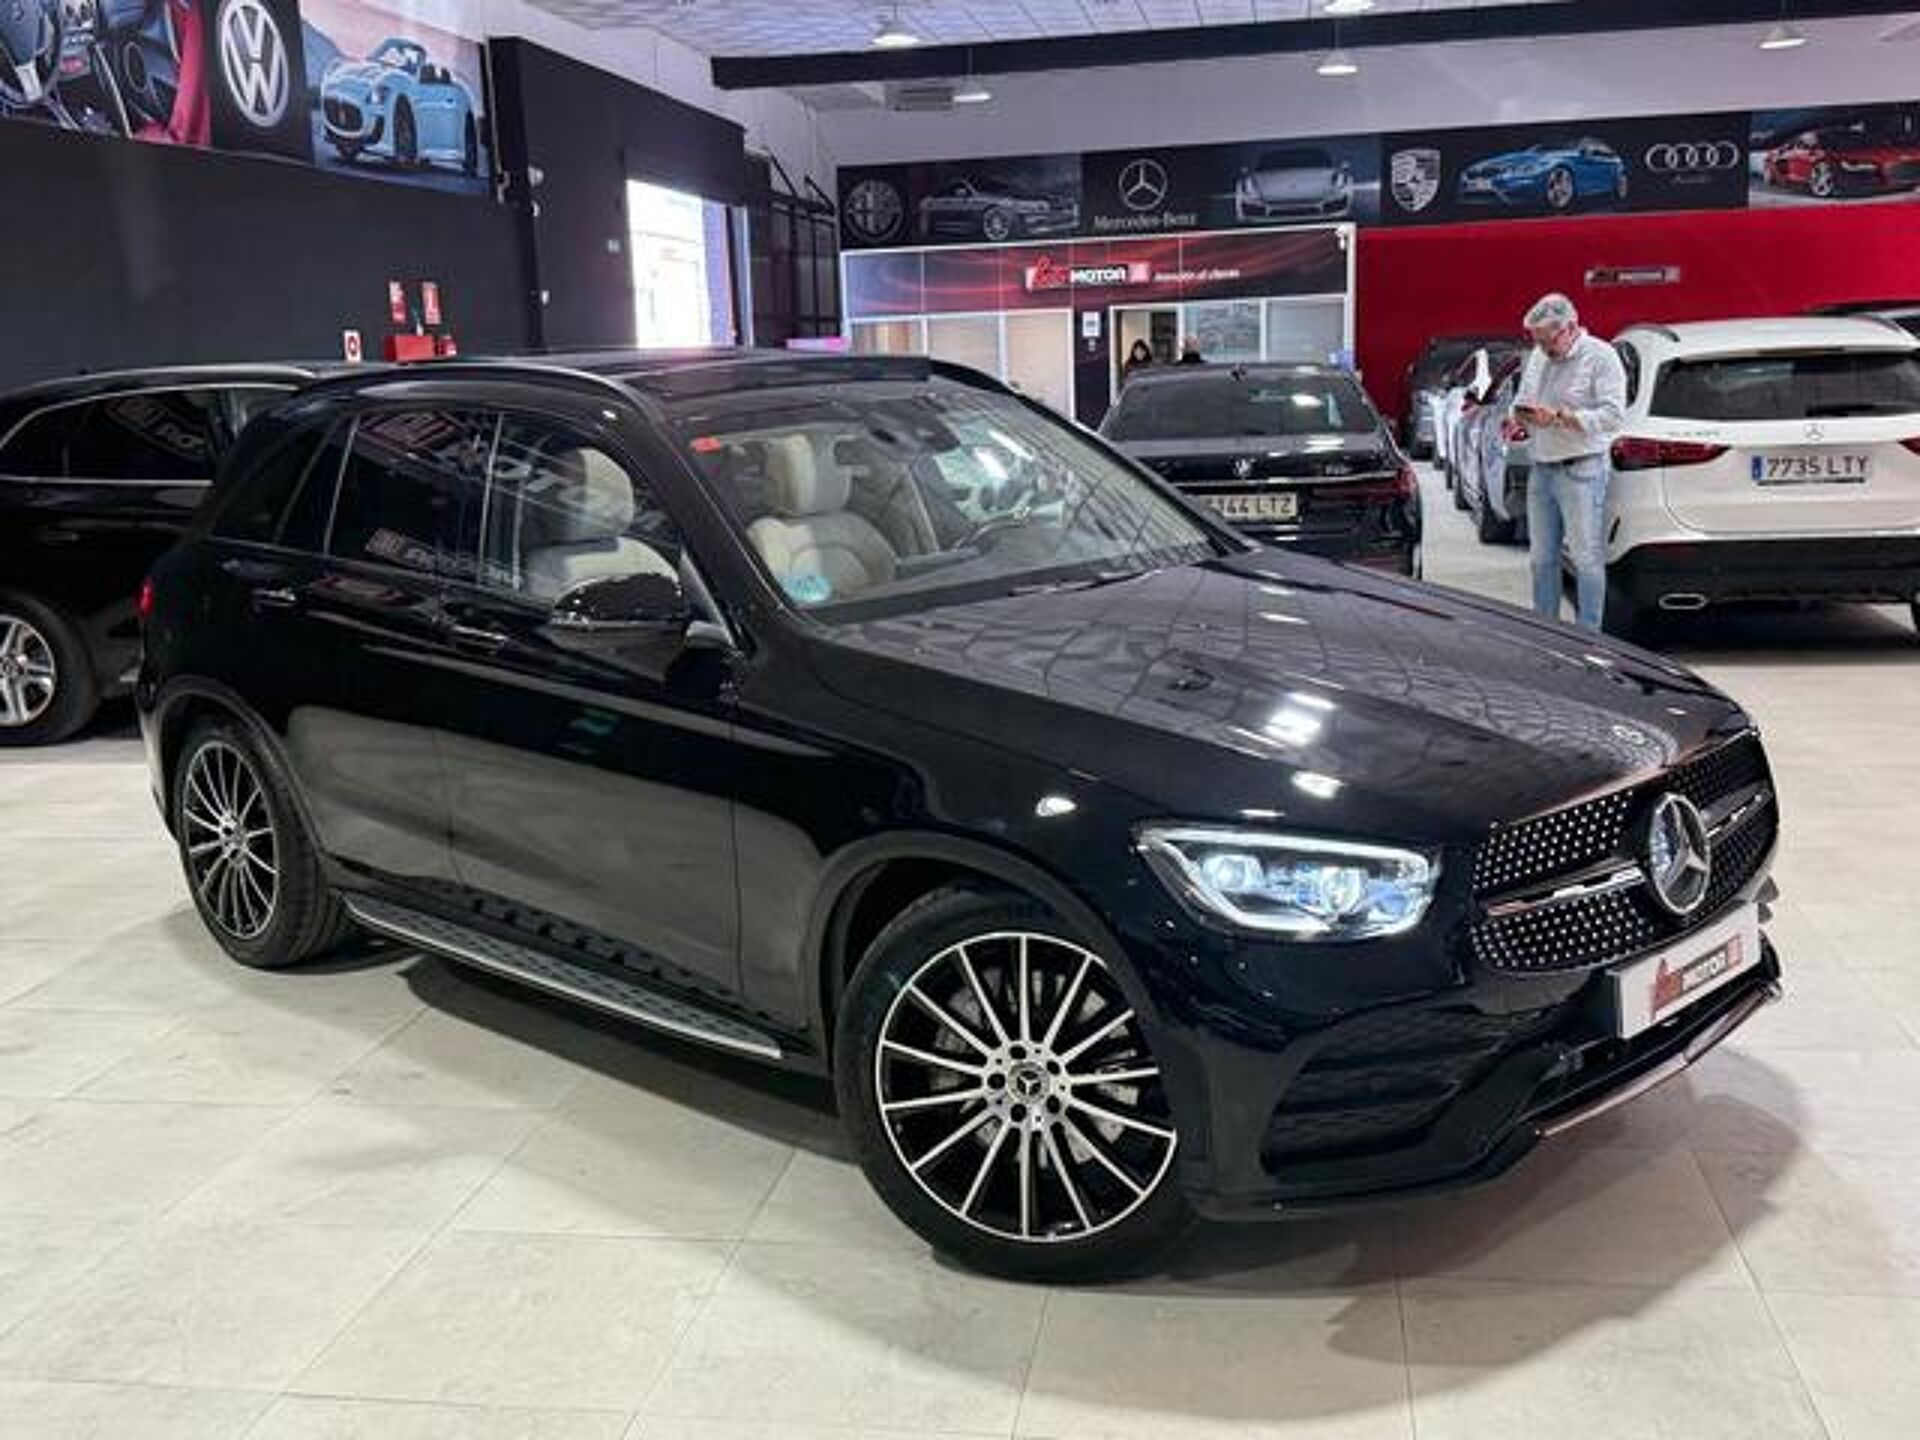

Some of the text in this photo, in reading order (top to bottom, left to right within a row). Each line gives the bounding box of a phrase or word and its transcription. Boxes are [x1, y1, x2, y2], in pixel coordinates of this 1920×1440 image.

[1070, 267, 1126, 283] MOTOR
[1768, 455, 1869, 477] 7735 LTY
[1256, 496, 1290, 514] LTZ
